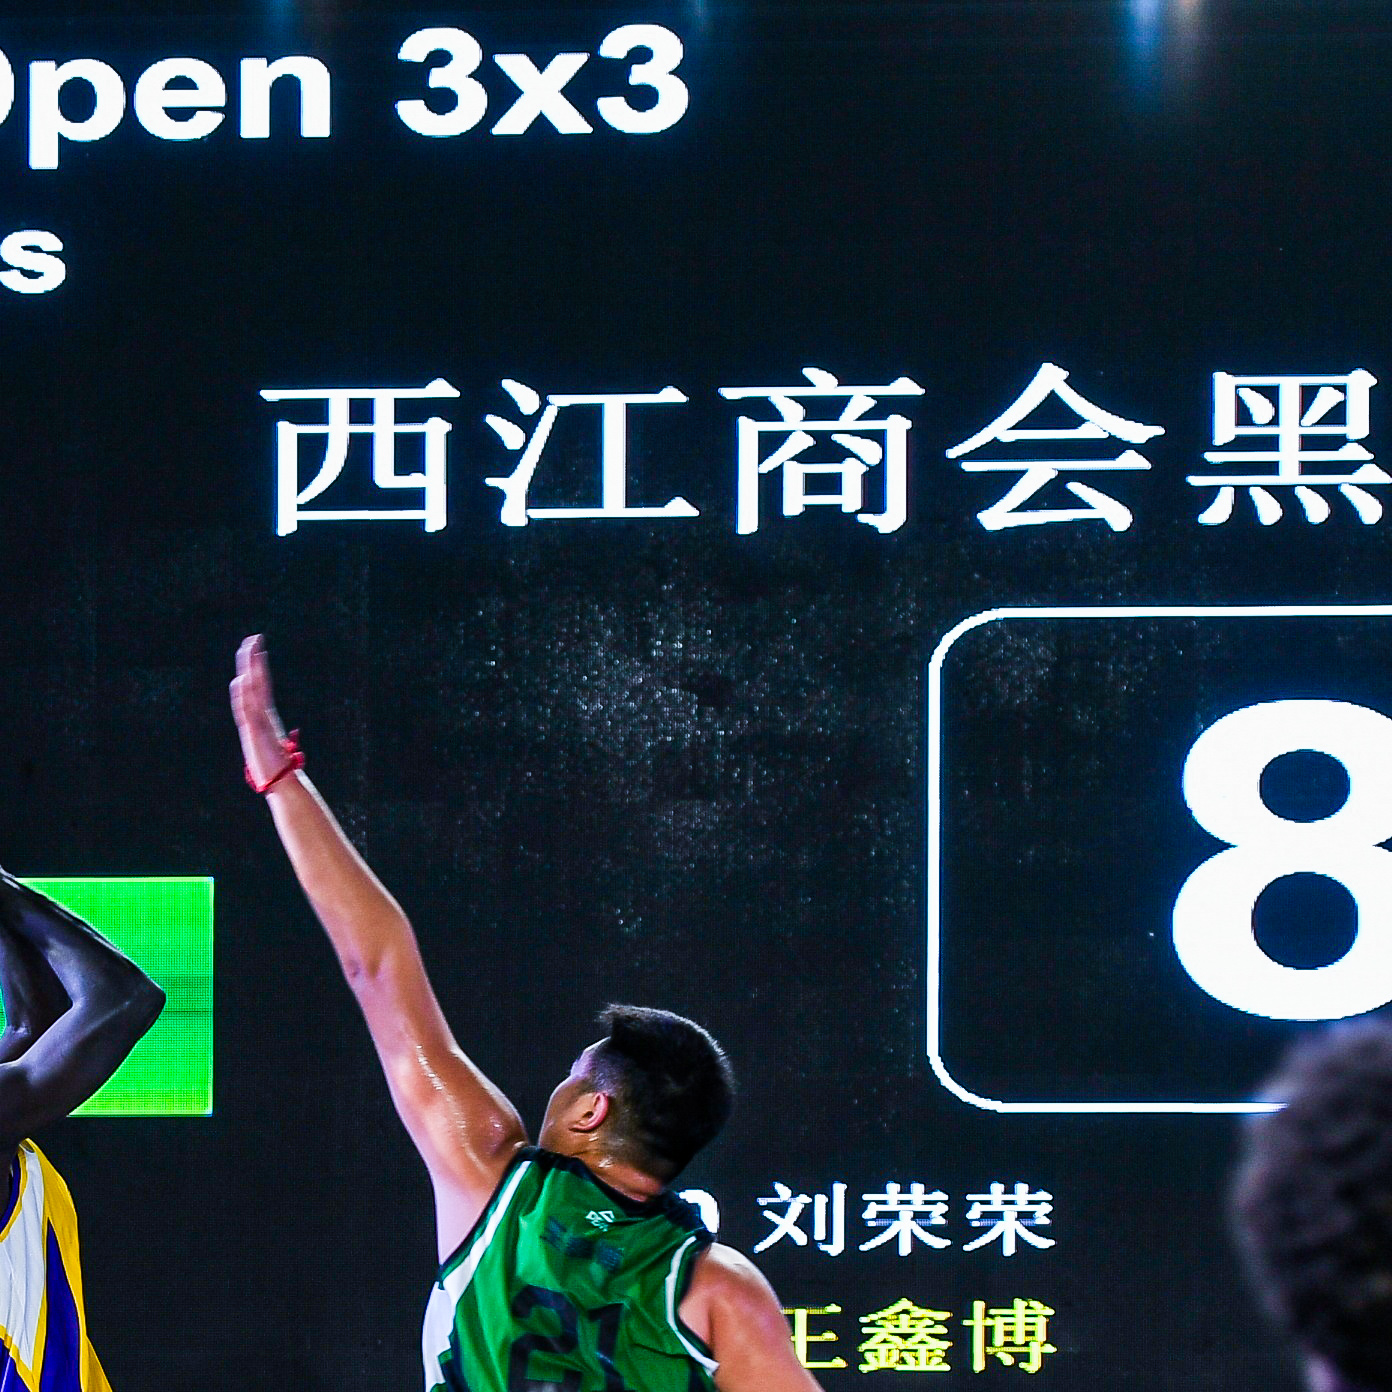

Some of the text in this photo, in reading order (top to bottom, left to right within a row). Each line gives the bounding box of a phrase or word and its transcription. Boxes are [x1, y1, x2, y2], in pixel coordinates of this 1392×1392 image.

[395, 24, 689, 138] 3x3
[754, 1181, 1056, 1257] 刘荣荣
